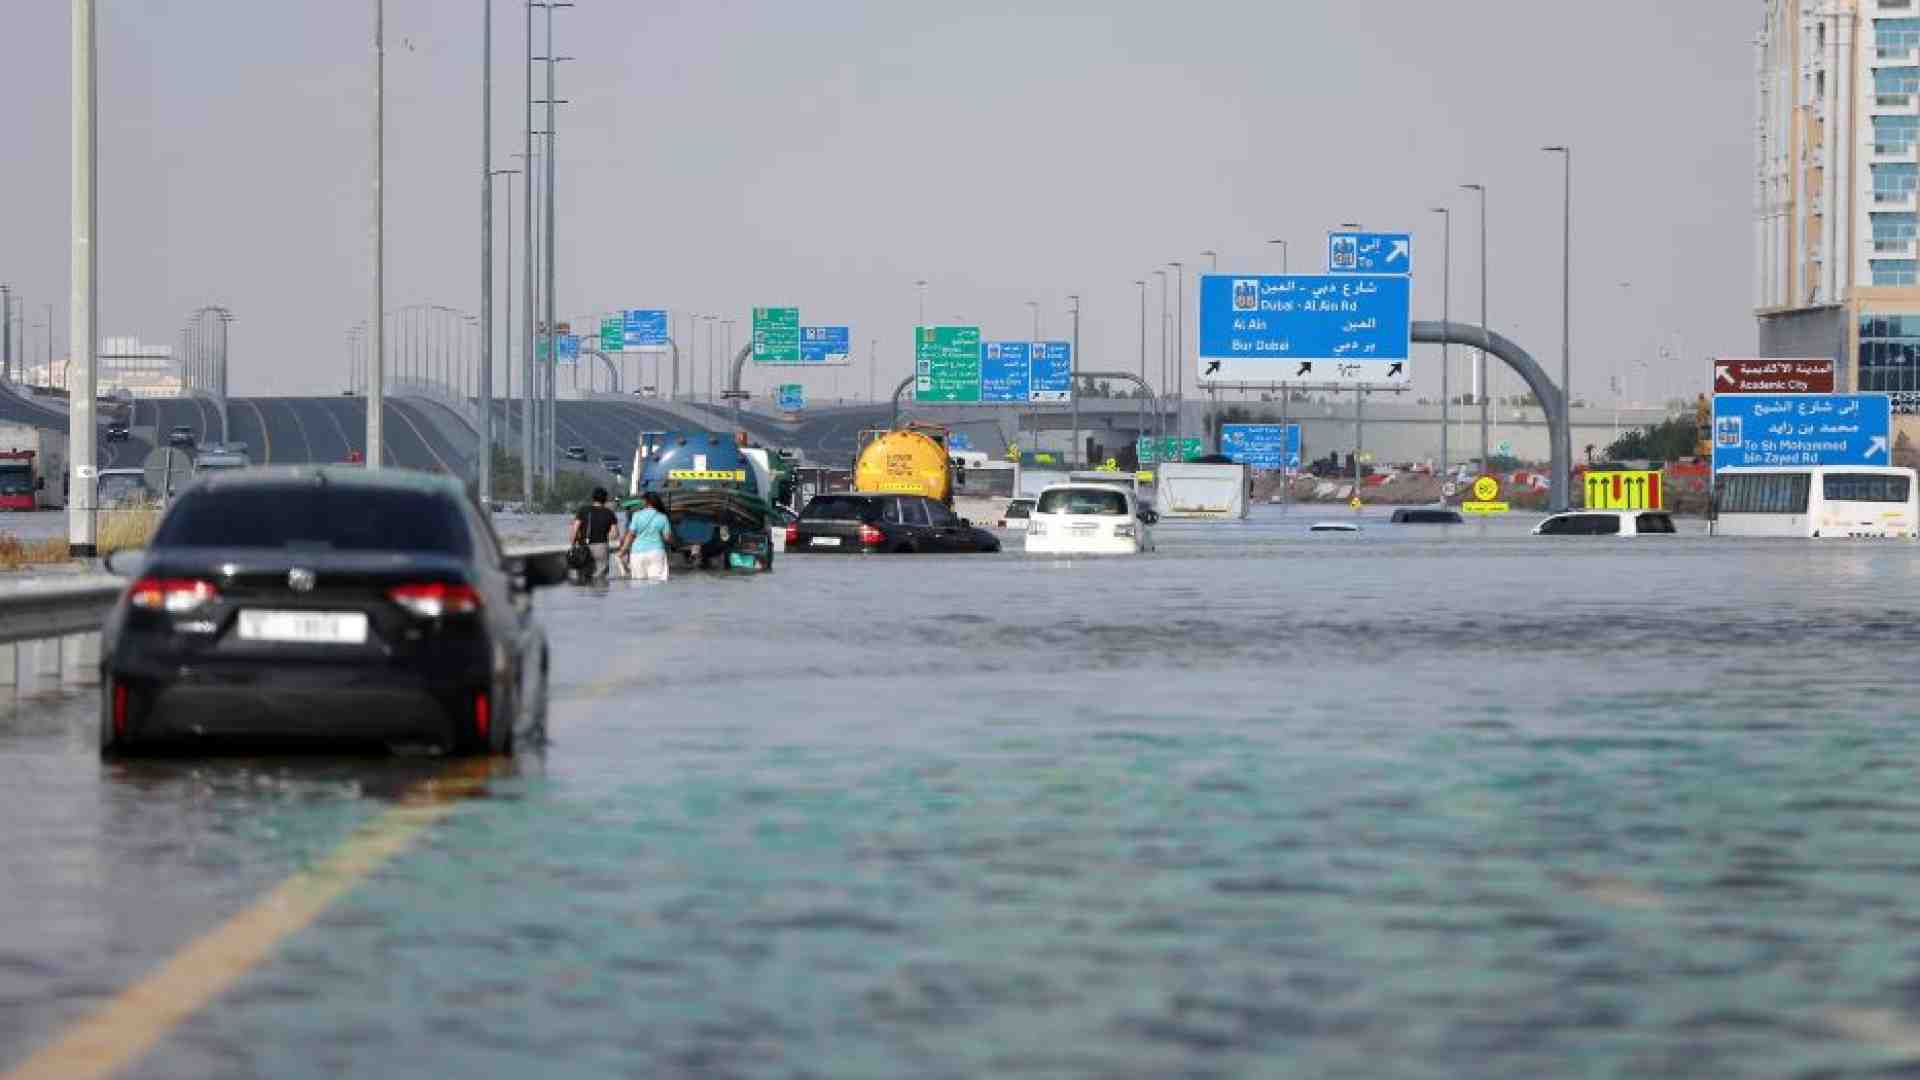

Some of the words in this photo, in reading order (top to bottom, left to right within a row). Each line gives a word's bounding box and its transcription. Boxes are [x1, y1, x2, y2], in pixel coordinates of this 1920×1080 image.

[1358, 256, 1374, 267] To
[1261, 280, 1296, 295] العين
[1312, 285, 1336, 299] دبي
[1343, 281, 1377, 296] شارع
[1261, 300, 1293, 311] Dubai
[1304, 300, 1316, 311] Al
[1319, 300, 1338, 311] Ain
[1341, 300, 1357, 311] Rd
[1233, 319, 1246, 330] Al
[1249, 319, 1267, 330] Ain
[1343, 318, 1376, 332] العين
[1232, 340, 1252, 351] Bur
[1256, 339, 1289, 351] Dubai
[1332, 341, 1359, 356] دبي
[1363, 344, 1376, 354] بر
[1795, 362, 1832, 375] المدينة
[1739, 379, 1785, 390] Academic
[1788, 379, 1808, 392] City
[1753, 400, 1793, 416] الشيخ
[1798, 400, 1833, 416] شارع
[1838, 400, 1859, 418] إلى
[1768, 421, 1793, 435] زايد
[1820, 424, 1859, 433] محمد
[1744, 440, 1758, 450] To
[1761, 440, 1777, 451] Sh
[1780, 440, 1847, 451] Mohammed
[1744, 452, 1761, 463] bin
[1764, 452, 1799, 466] Zayed
[1802, 452, 1818, 463] Rd
